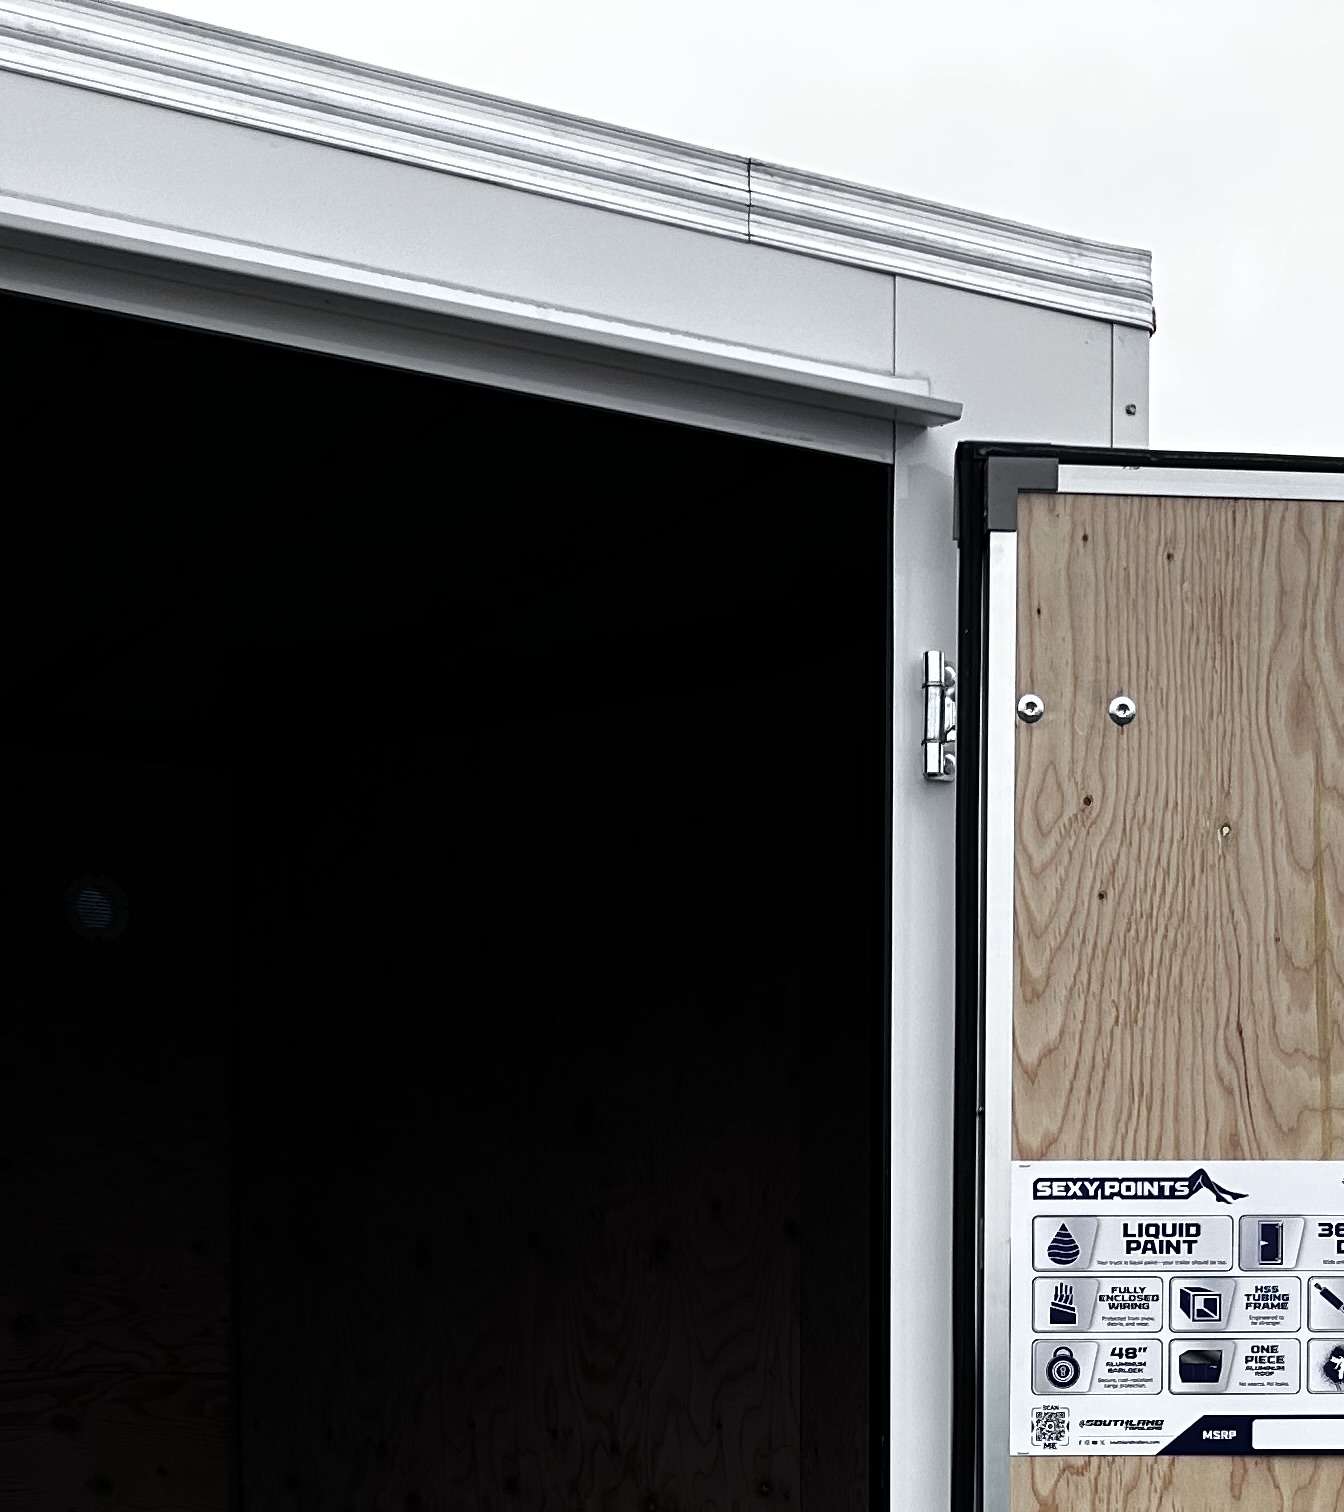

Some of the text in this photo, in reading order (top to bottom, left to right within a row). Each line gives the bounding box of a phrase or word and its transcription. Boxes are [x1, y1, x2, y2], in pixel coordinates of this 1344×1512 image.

[1036, 1181, 1190, 1197] SEXY POINTS
[1122, 1222, 1202, 1239] LIQUID
[1125, 1239, 1199, 1255] PAINT
[1111, 1286, 1147, 1294] FULLY
[1254, 1285, 1279, 1294] HSS
[1098, 1294, 1160, 1302] ENCLOSED
[1244, 1293, 1290, 1302] TUBING
[1107, 1302, 1150, 1310] WIRING
[1245, 1302, 1289, 1310] FRAME
[1109, 1346, 1148, 1360] 48"
[1250, 1344, 1280, 1354] ONE
[1244, 1355, 1286, 1365] PIECE
[1202, 1430, 1237, 1440] MSRP
